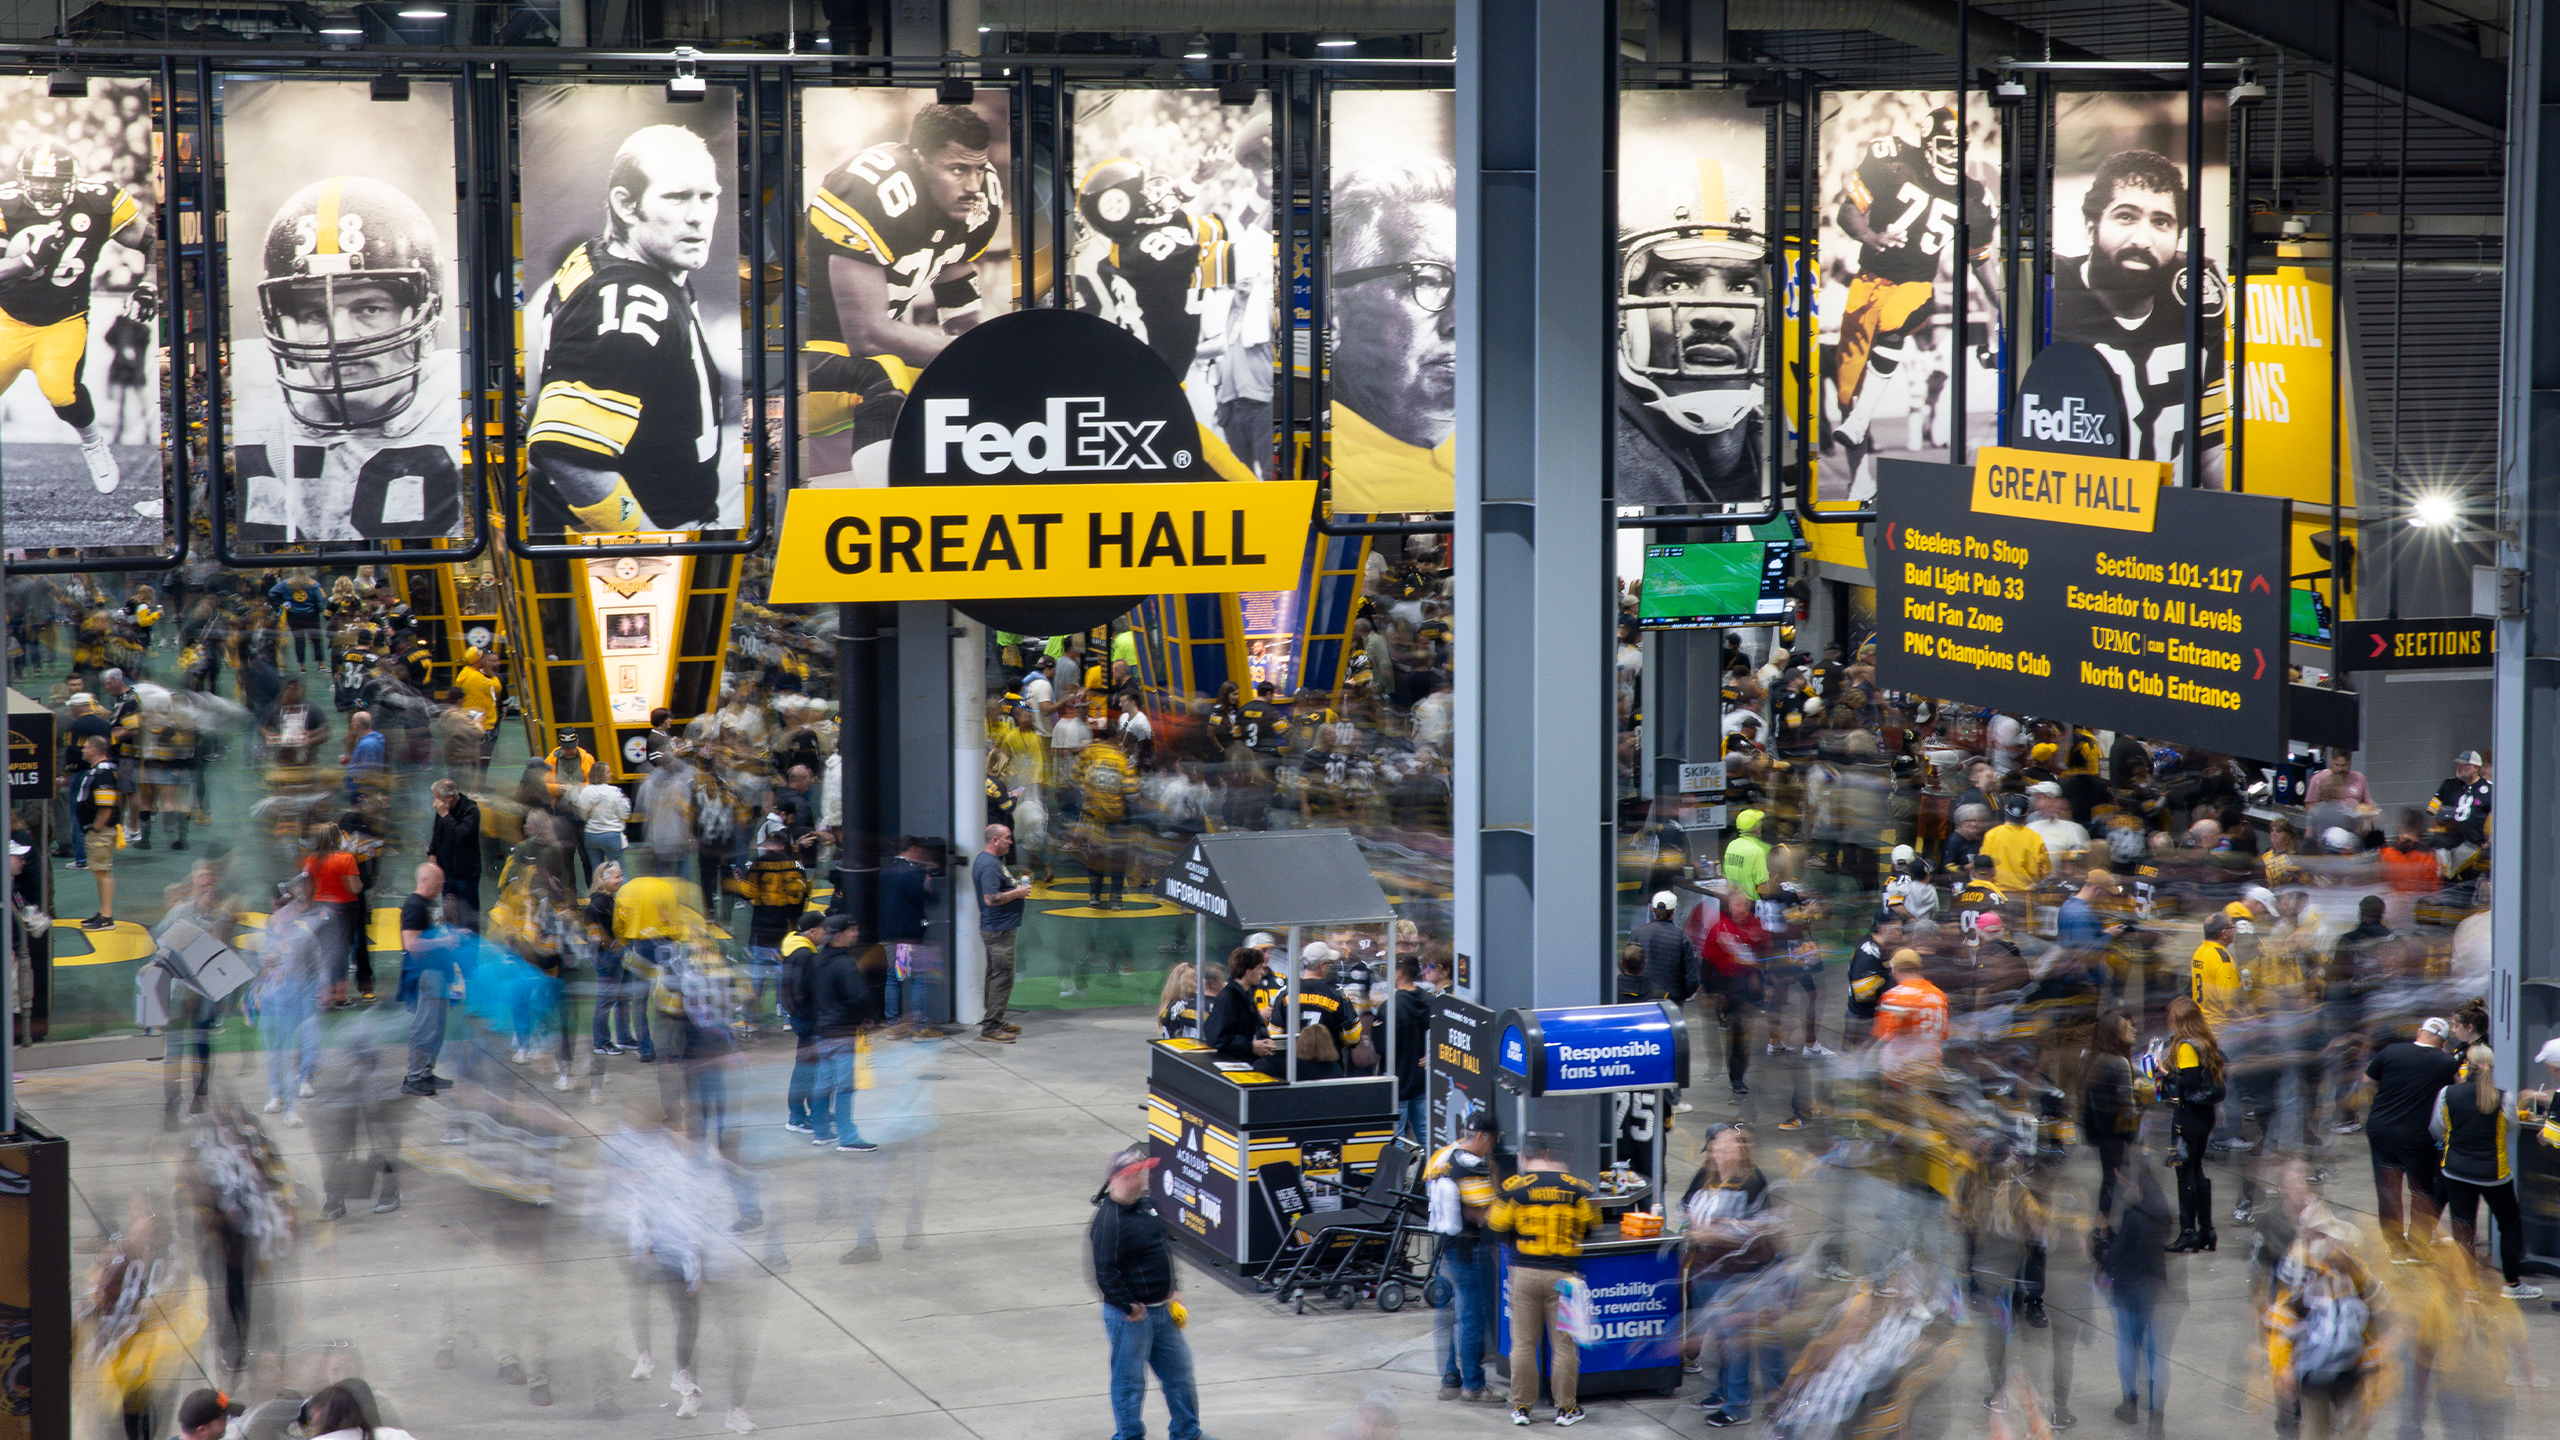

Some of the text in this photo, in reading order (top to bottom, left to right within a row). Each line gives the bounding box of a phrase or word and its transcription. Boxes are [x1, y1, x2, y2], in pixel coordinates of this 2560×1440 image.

[1897, 181, 1958, 256] 75
[598, 283, 669, 347] 12
[2022, 393, 2107, 445] FedEx
[924, 396, 1168, 475] FedEx
[1988, 464, 2141, 514] GREAT HALL
[824, 509, 1267, 576] GREAT HALL
[1903, 527, 2029, 570] Steelers Pro Shop
[1904, 562, 2024, 601] Bud Light Pub 33
[2095, 551, 2243, 594] Sections 101-117
[1904, 597, 2004, 633] Ford Fan Zone
[2066, 585, 2242, 633] Escalator to All Levels
[1903, 631, 2051, 678] PNC Champions Club
[2091, 625, 2242, 672] UPMC CLUB Entrance
[2393, 630, 2482, 658] SECTIONS
[344, 661, 364, 690] 36
[2080, 660, 2242, 711] North Club Entrance
[1246, 722, 1258, 748] 3
[8, 762, 39, 771] MPIONS
[8, 772, 40, 786] AILS
[1684, 765, 1711, 778] SKIP
[1693, 776, 1722, 790] LINE
[2454, 795, 2474, 822] 8
[1166, 877, 1228, 918] INFORMATION
[1448, 1027, 1472, 1052] FEDEX
[1559, 1040, 1661, 1063] Responsible
[1438, 1043, 1461, 1067] GREAT
[1462, 1053, 1481, 1075] HALL
[1560, 1060, 1635, 1080] fans win.
[1176, 1148, 1209, 1175] ACRISURE
[1275, 1186, 1299, 1201] HERE
[1582, 1281, 1656, 1302] ponsibility
[1604, 1299, 1667, 1315] rewards.
[1606, 1319, 1666, 1340] LIGHT
